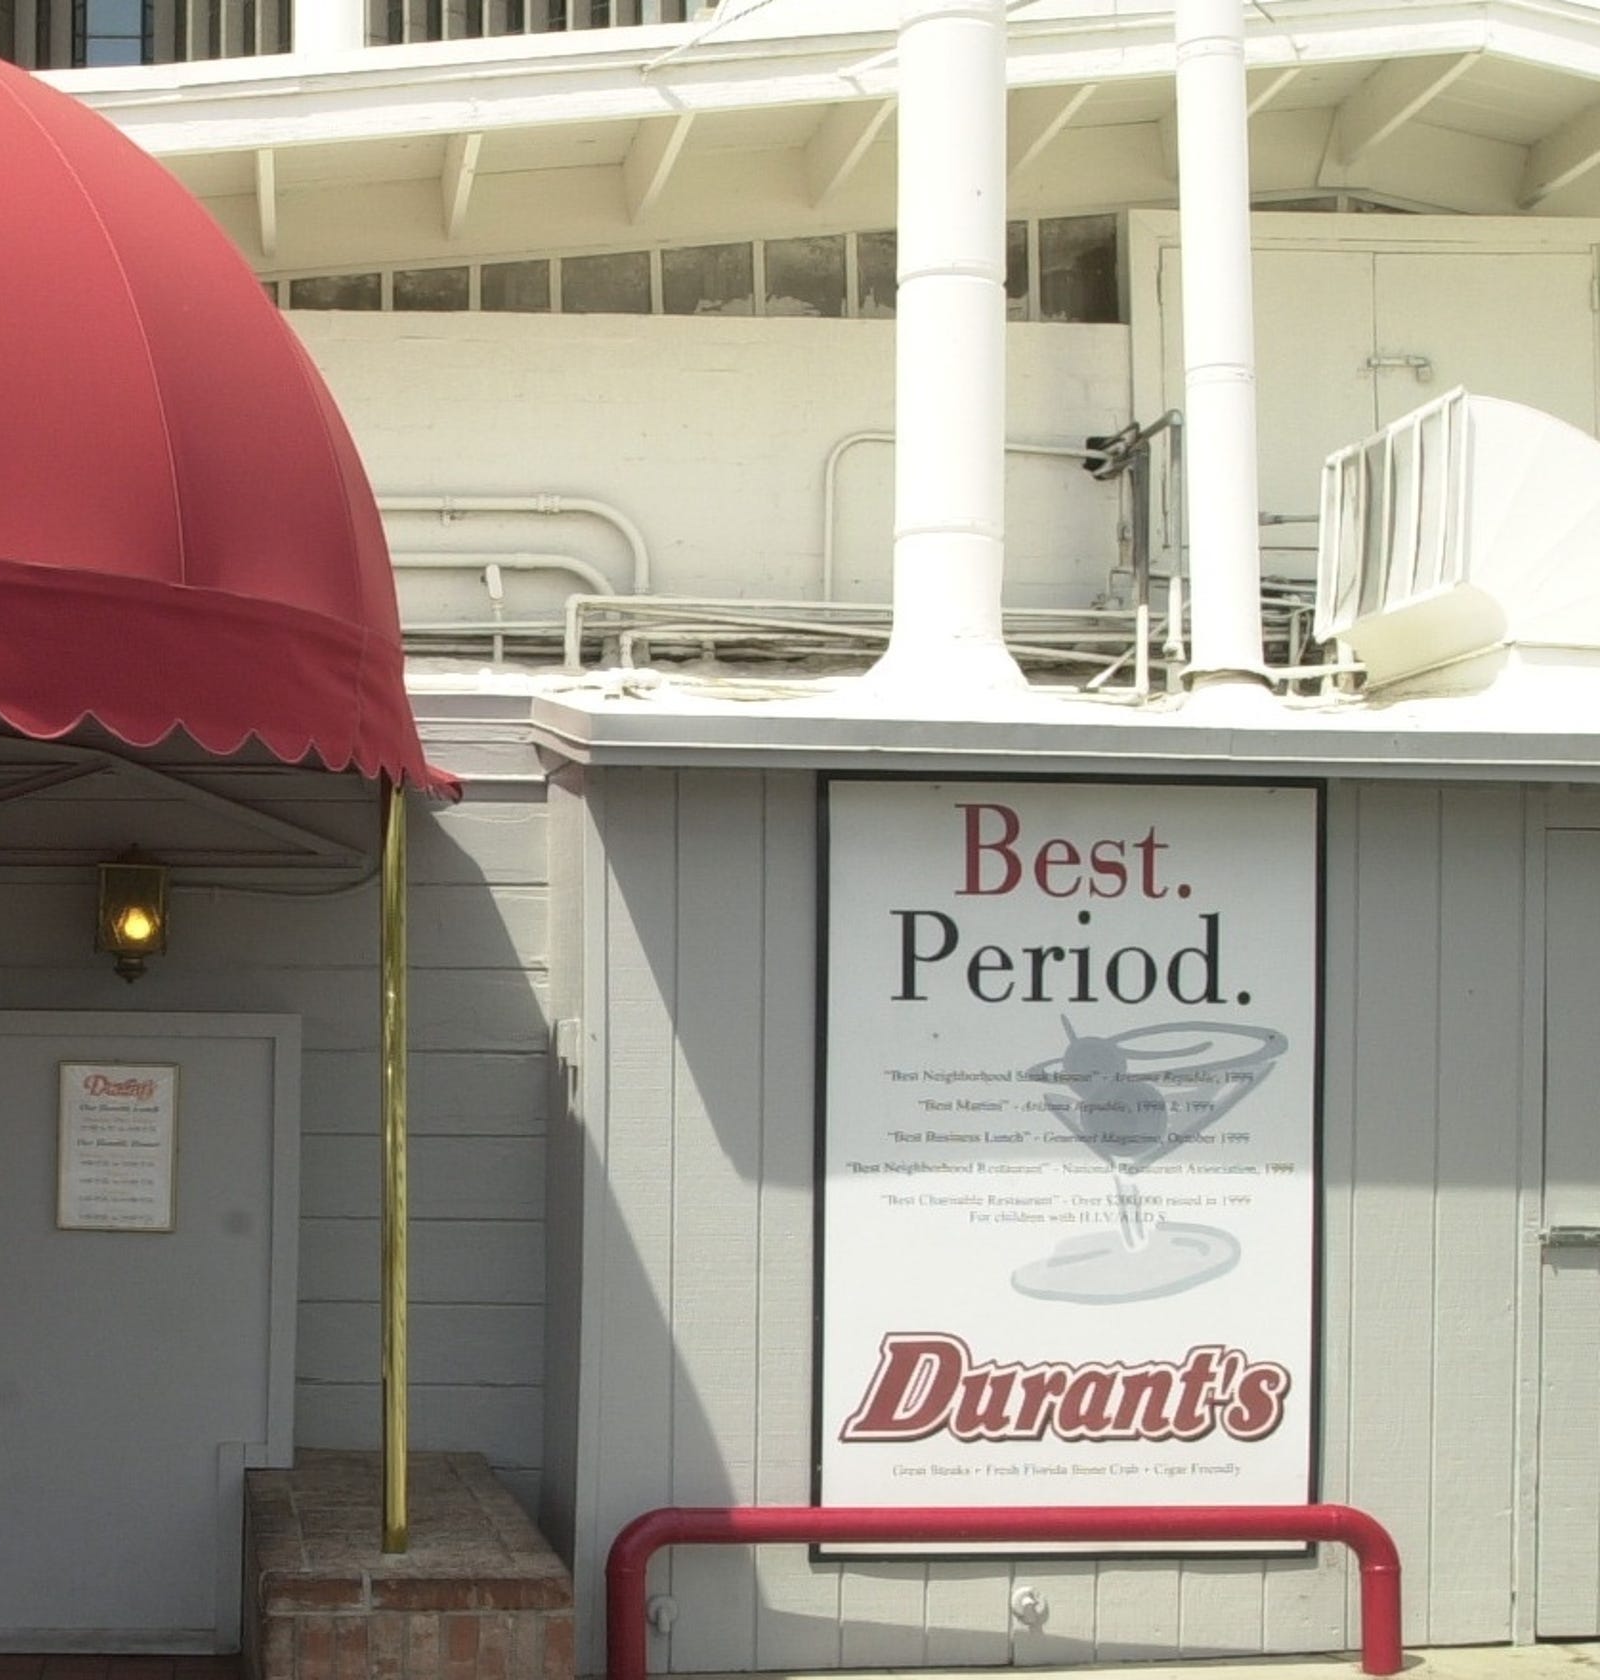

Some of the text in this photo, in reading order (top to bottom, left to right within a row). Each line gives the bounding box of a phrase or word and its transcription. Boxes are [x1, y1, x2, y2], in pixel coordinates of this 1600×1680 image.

[954, 803, 1193, 899] Best.
[889, 910, 1253, 1005] Period.
[838, 1331, 1291, 1443] Durant's
